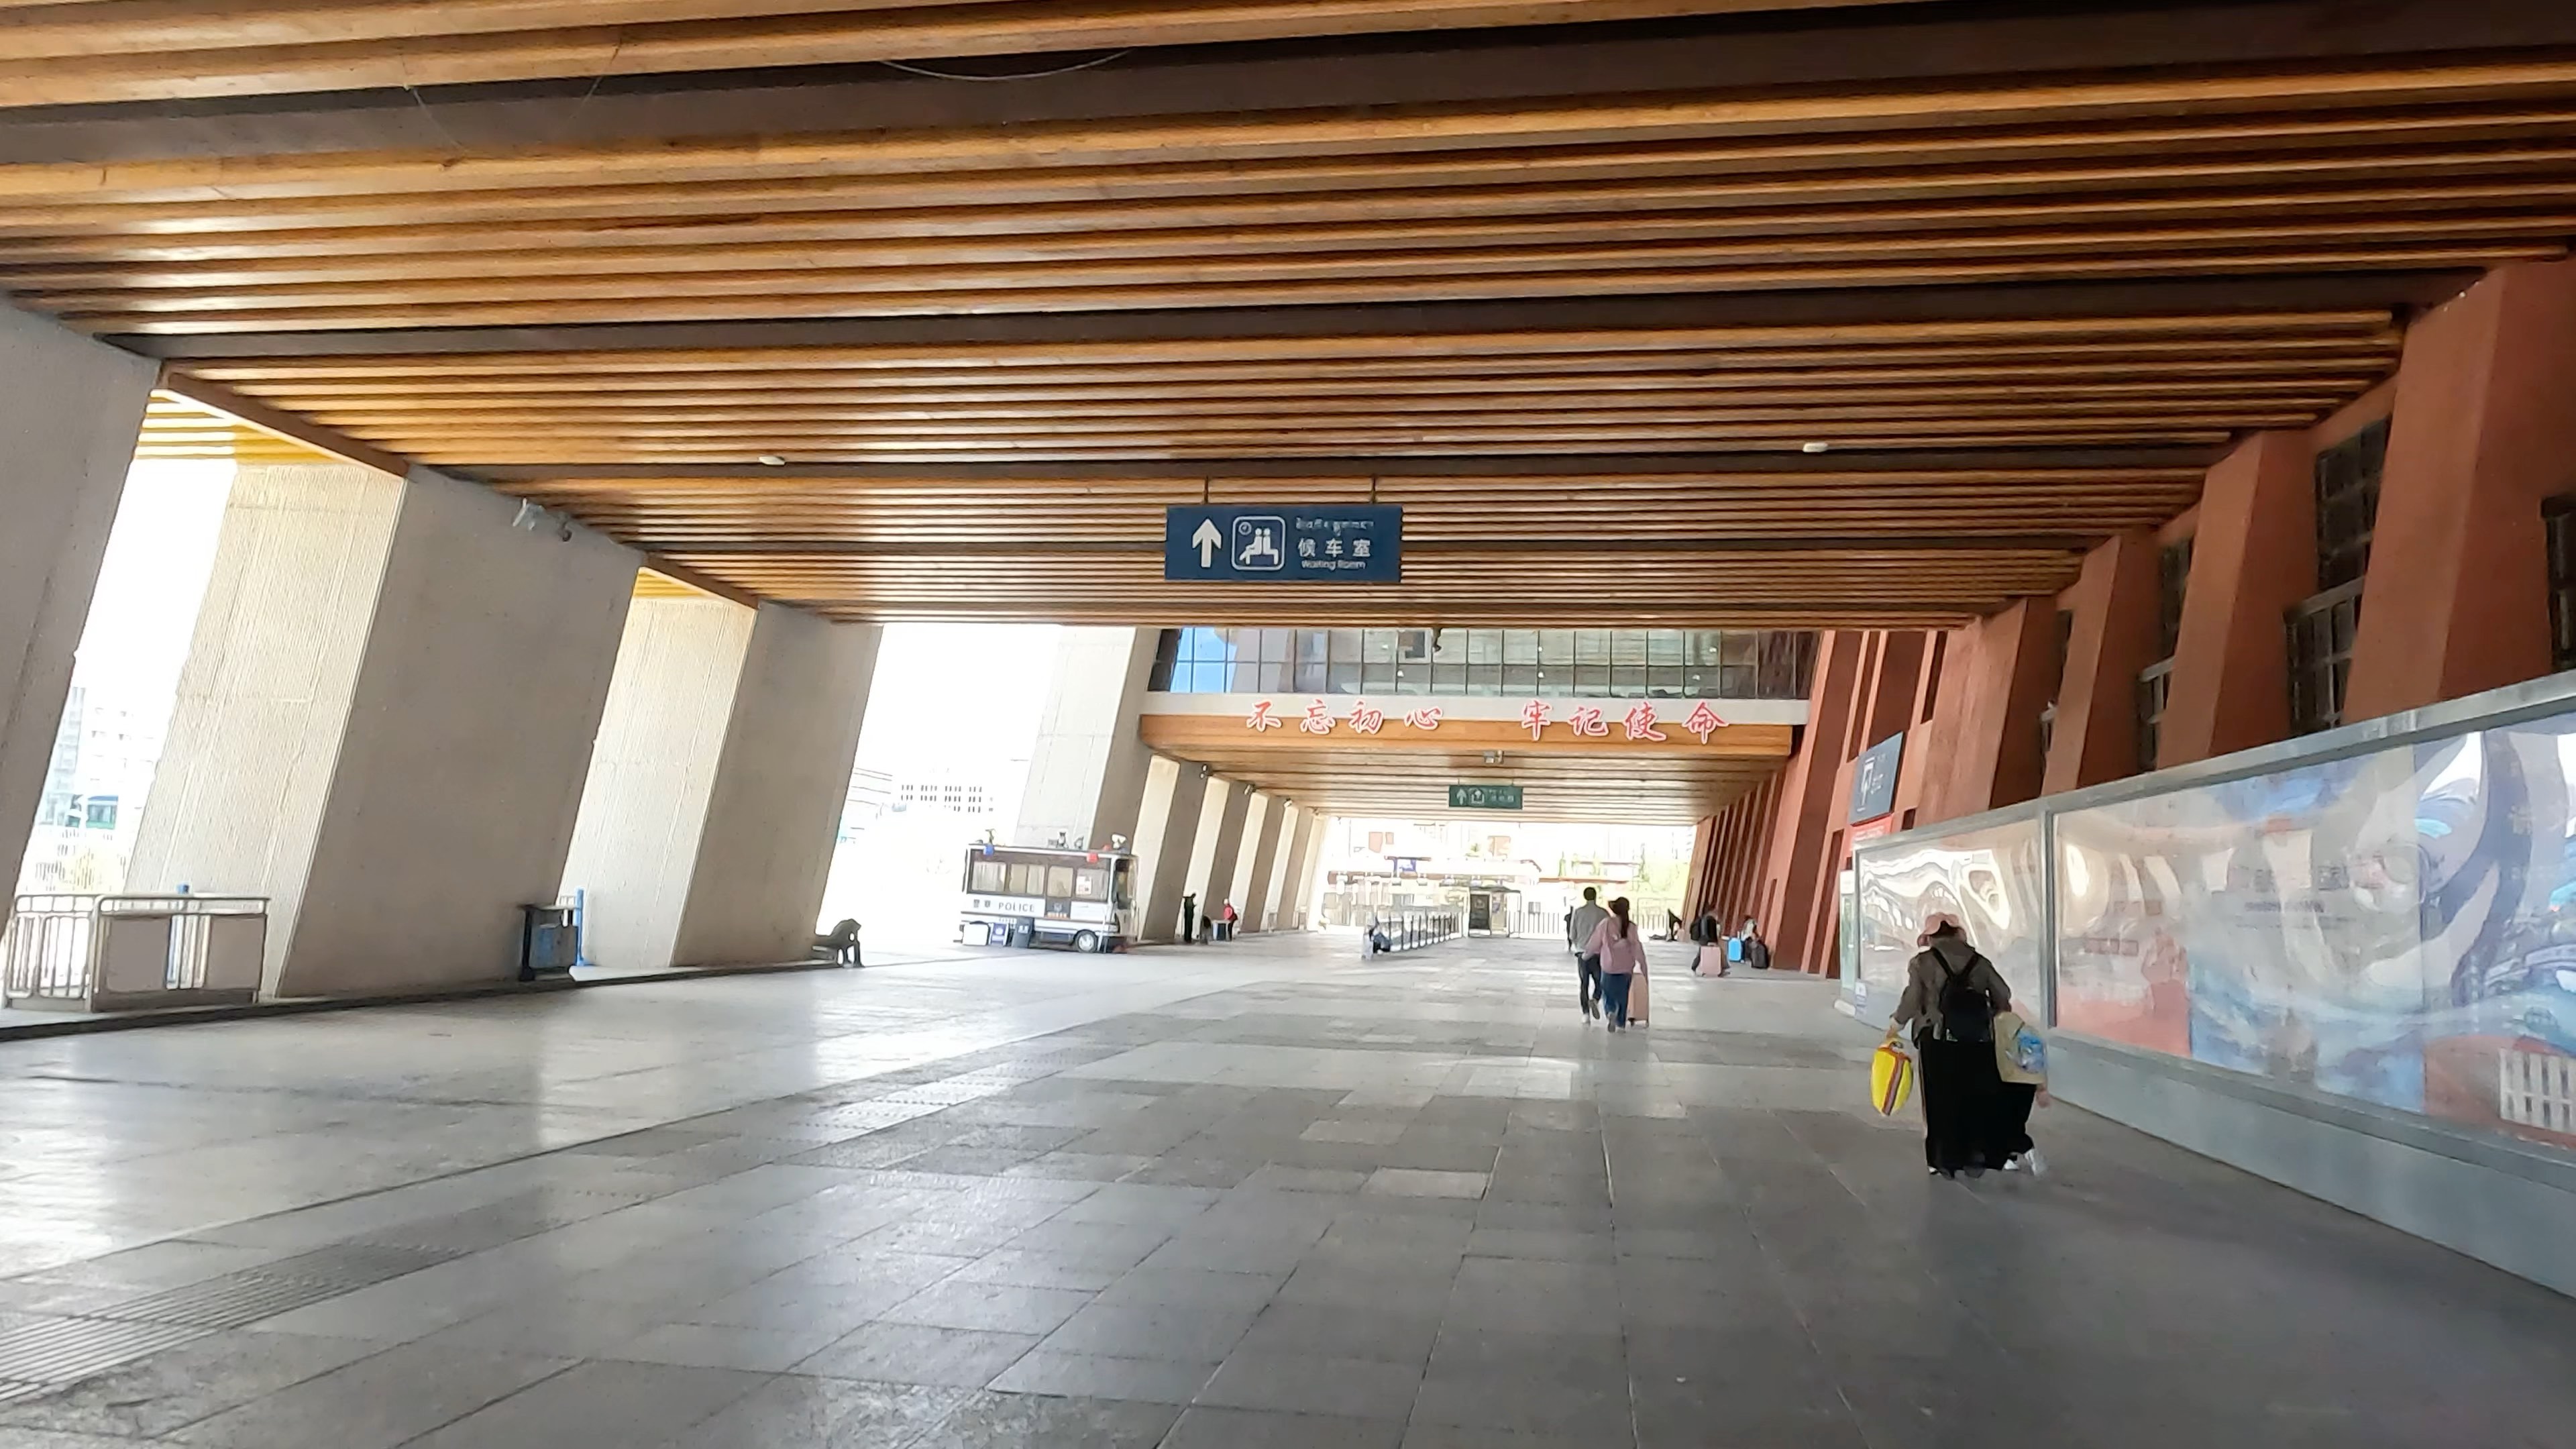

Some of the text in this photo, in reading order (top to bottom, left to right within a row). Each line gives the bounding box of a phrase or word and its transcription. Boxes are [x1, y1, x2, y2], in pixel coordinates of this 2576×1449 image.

[1297, 537, 1371, 557] 候车室
[1301, 559, 1336, 571] Waiting
[1246, 698, 1729, 745] 不忘初心 牢记使命
[998, 902, 1035, 913] POLICE
